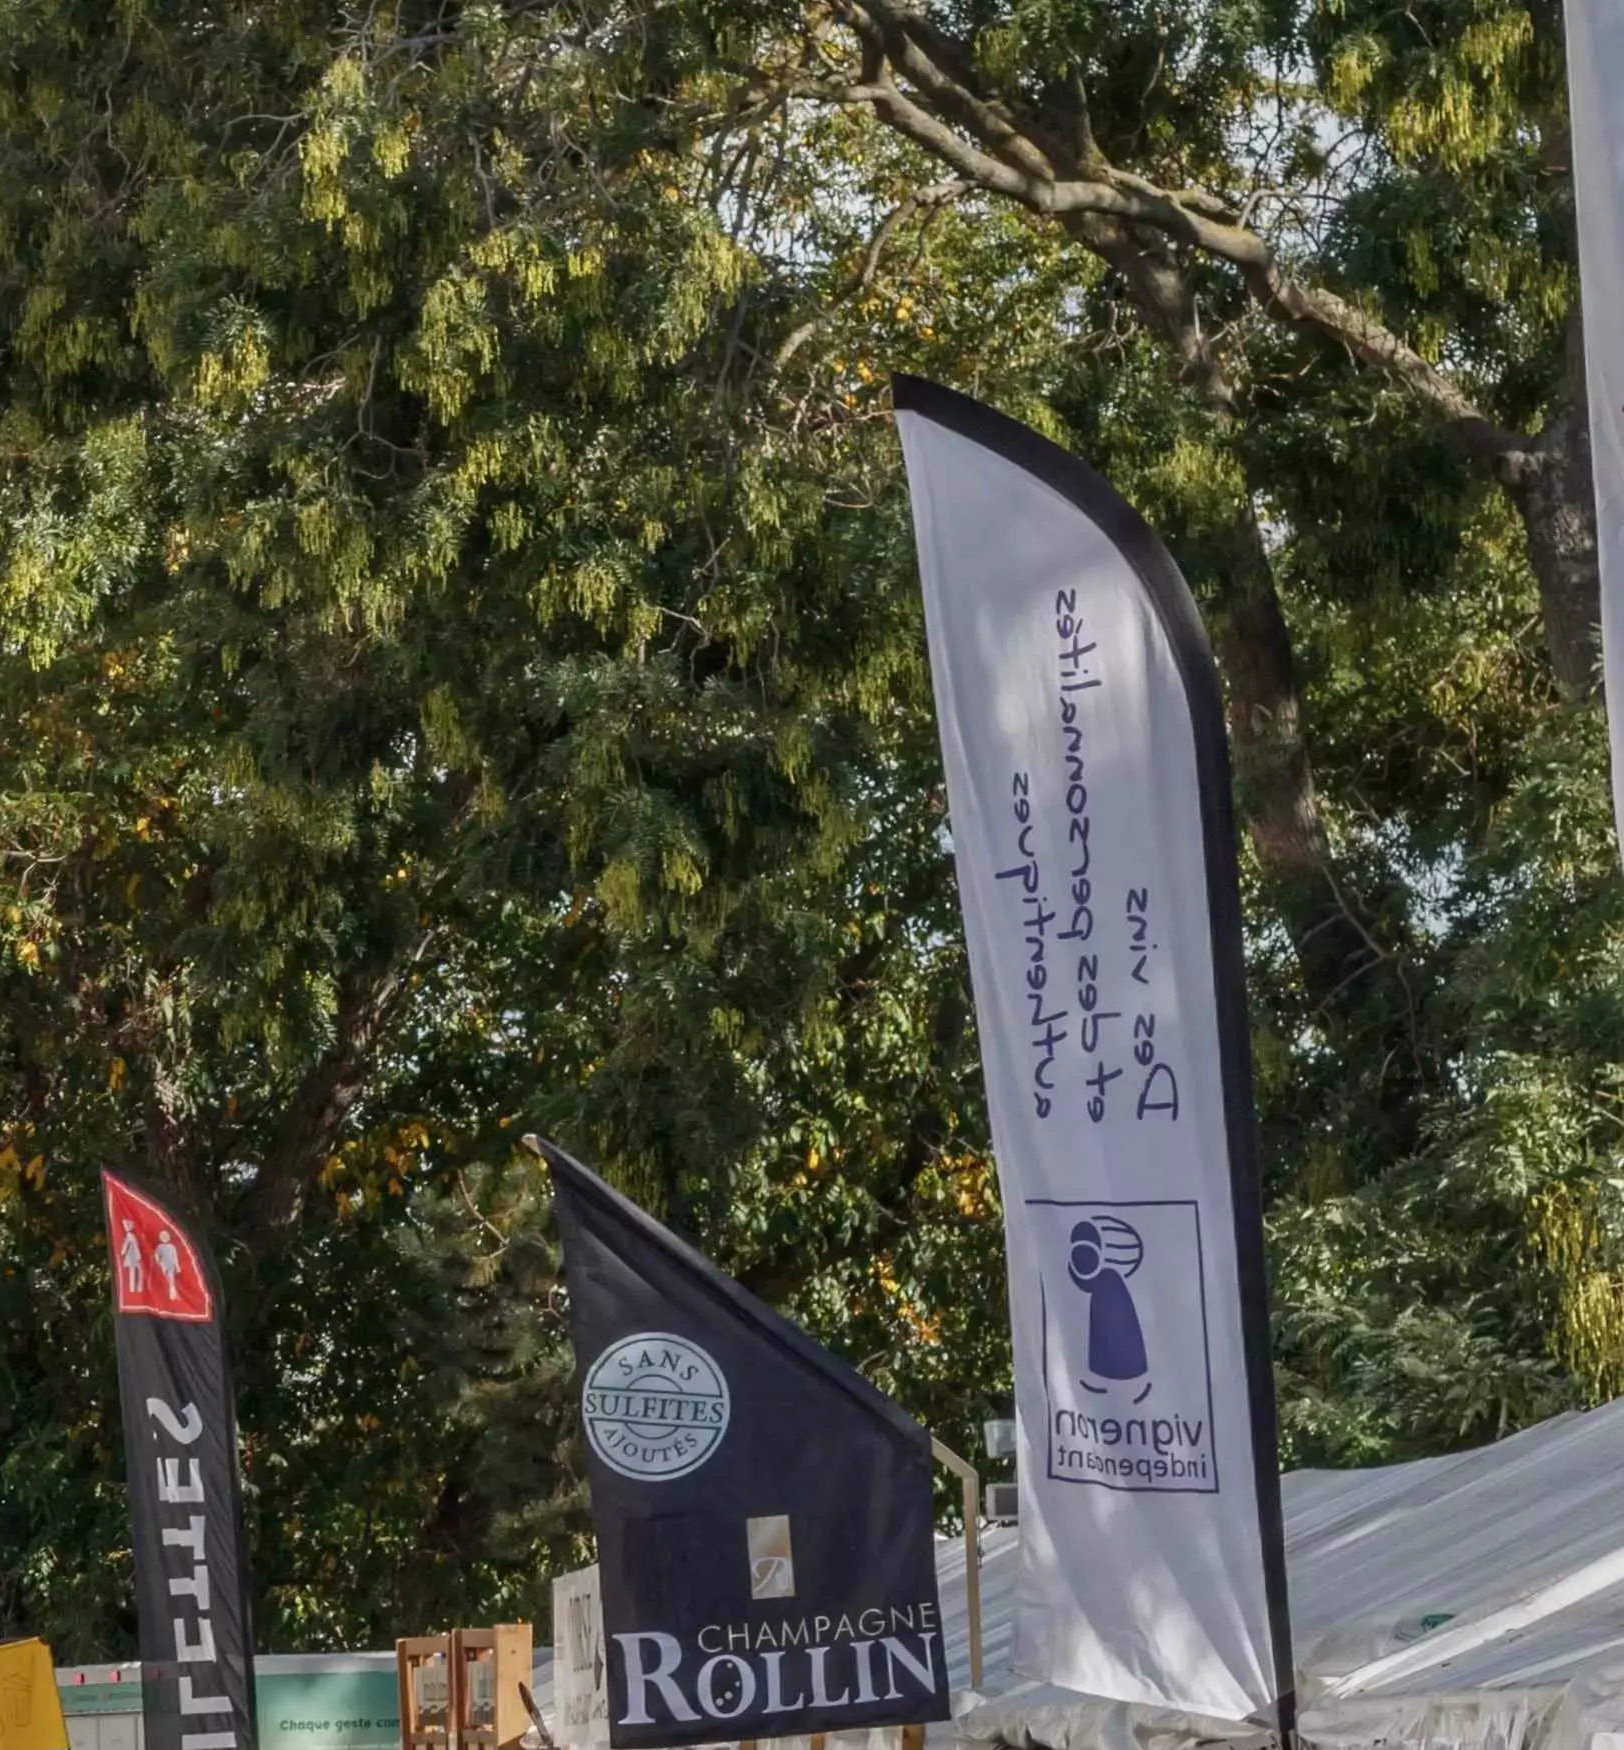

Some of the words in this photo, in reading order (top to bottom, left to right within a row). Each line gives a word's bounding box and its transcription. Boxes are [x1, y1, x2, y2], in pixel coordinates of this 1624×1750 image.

[618, 1349, 699, 1381] SANS
[584, 1392, 725, 1424] SULFITES
[604, 1427, 698, 1463] AJOUTÉS
[697, 1602, 938, 1653] CHAMPAGNE
[611, 1631, 938, 1726] ROLLIN
[280, 1719, 331, 1734] Chaque
[334, 1717, 372, 1734] geste
